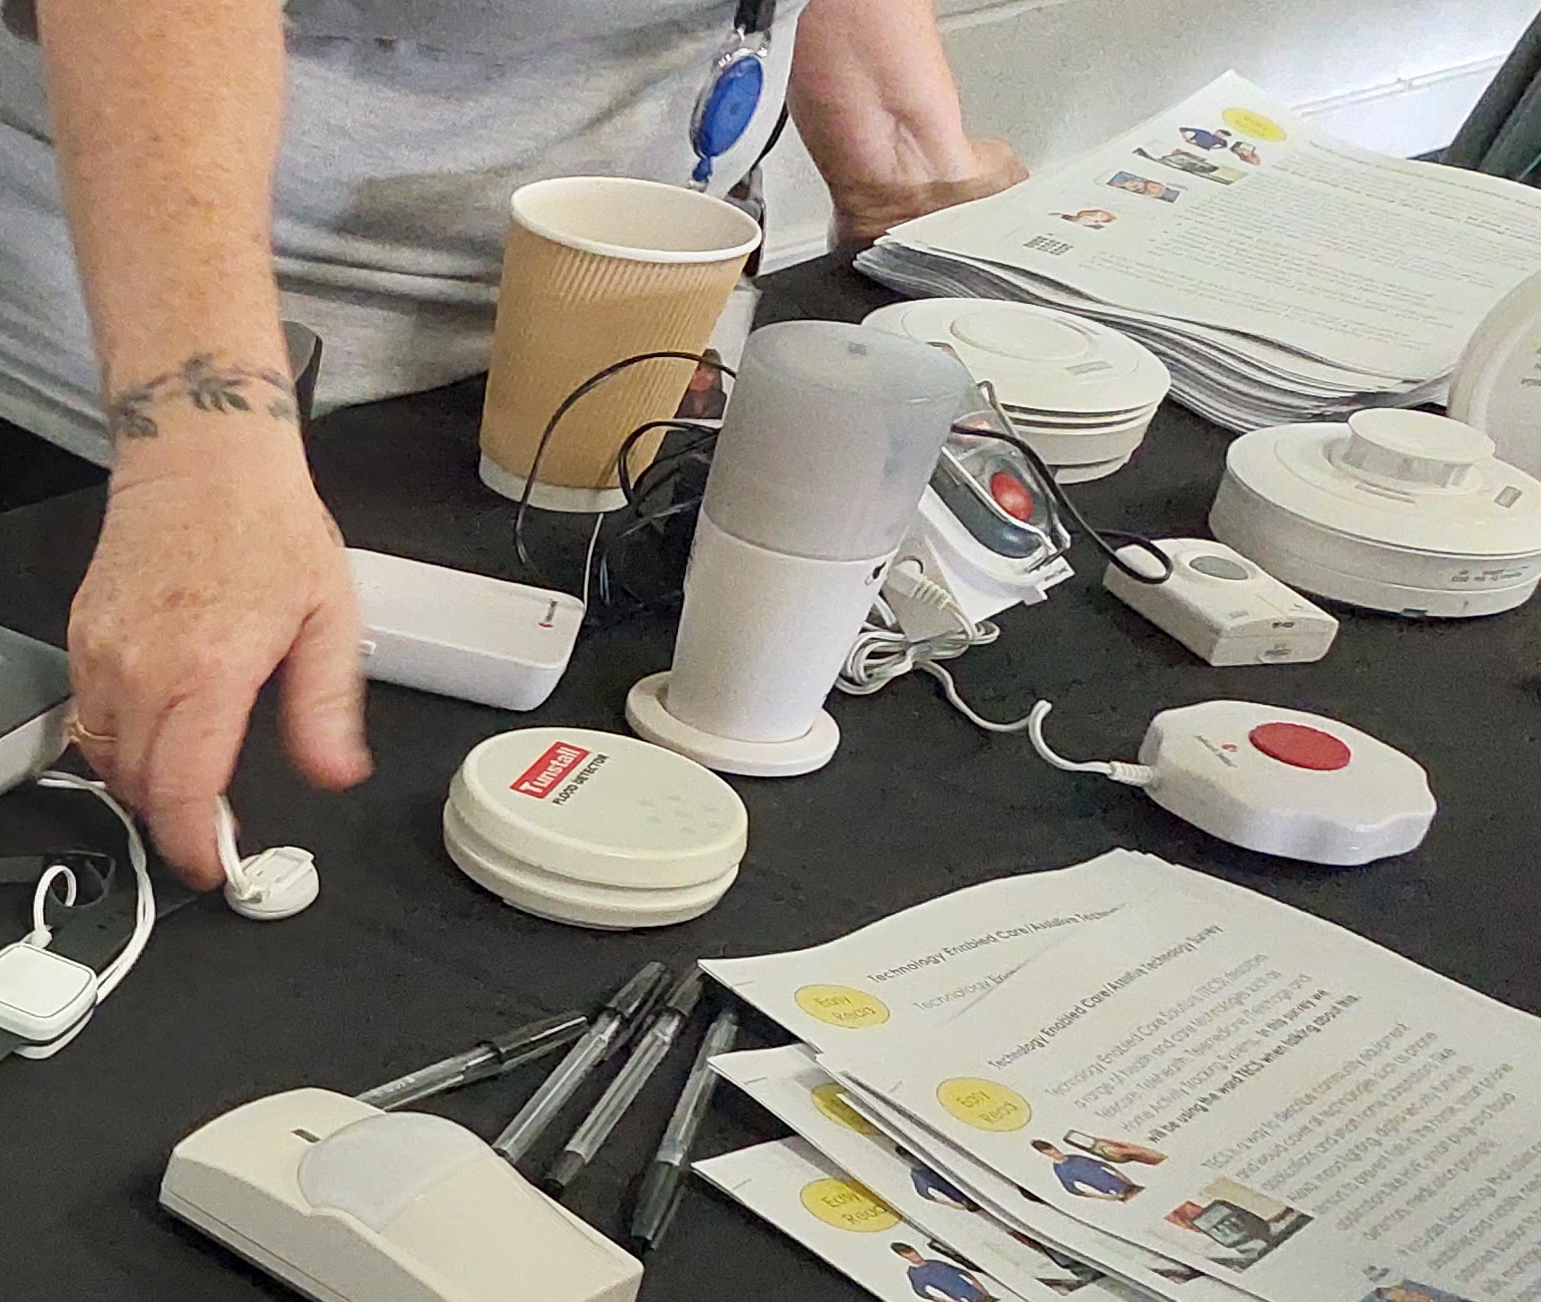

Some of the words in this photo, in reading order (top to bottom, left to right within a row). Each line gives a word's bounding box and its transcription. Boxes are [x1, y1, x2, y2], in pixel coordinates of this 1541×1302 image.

[519, 746, 581, 793] Tunstall
[552, 779, 579, 806] FLOOD
[572, 753, 609, 786] DETECTOR
[867, 952, 946, 984] Technology
[944, 933, 997, 957] Enabled
[988, 1033, 1051, 1071] Technology
[1040, 1004, 1088, 1038] Enabled
[955, 1089, 991, 1109] Easy
[979, 1101, 1018, 1125] Read
